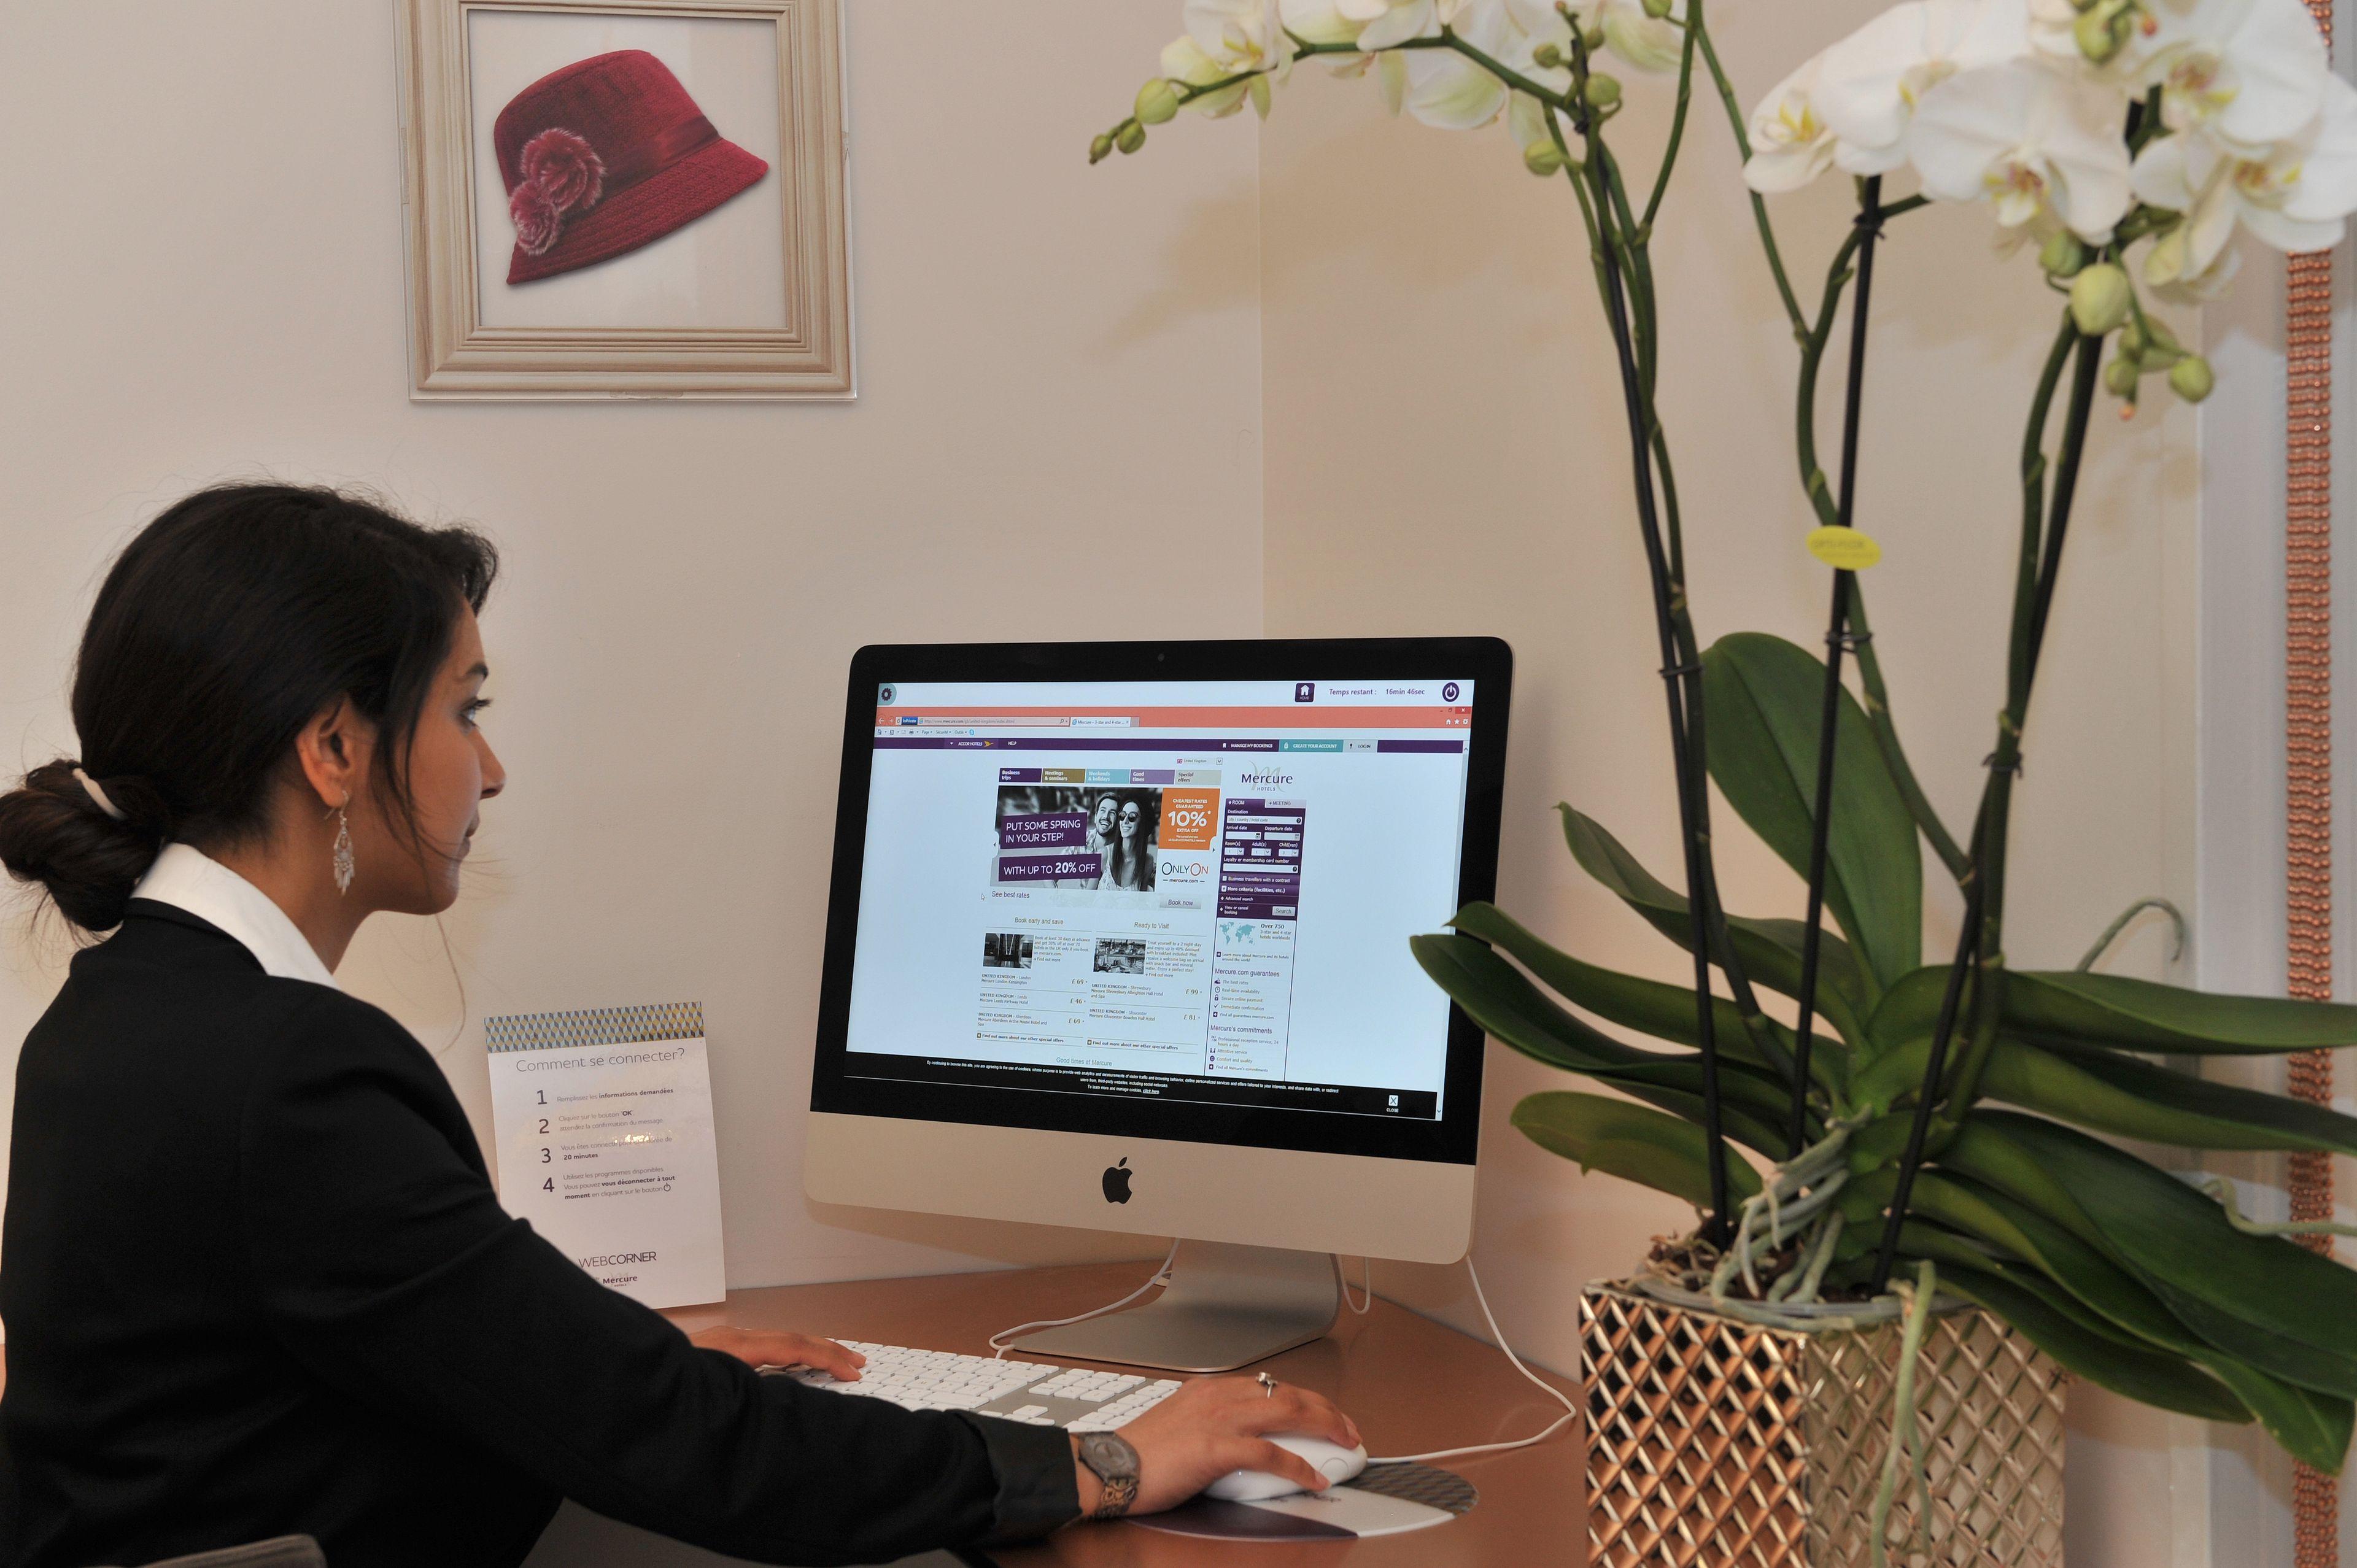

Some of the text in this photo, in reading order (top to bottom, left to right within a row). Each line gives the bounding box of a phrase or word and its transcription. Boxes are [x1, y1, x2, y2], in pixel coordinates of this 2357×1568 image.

[1241, 774, 1293, 784] Mercure
[1006, 819, 1081, 831] PUT SOME SPRING
[1005, 833, 1064, 843] IN YOUR STEP!
[1004, 862, 1096, 875] WITH UP TO 20% OFF
[516, 1047, 685, 1072] Comment se connecter?
[536, 1089, 548, 1105] 1
[557, 1094, 588, 1103] Remplissez
[598, 1091, 638, 1099] informations
[538, 1118, 550, 1134] 2
[592, 1121, 628, 1129] confirmation
[541, 1148, 551, 1164] 3
[543, 1177, 555, 1192] 4
[594, 1169, 632, 1179] programmes
[632, 1166, 664, 1175] disponibles
[617, 1176, 656, 1186] déconnecter
[578, 1251, 657, 1268] WEBCORNER
[603, 1275, 638, 1284] Mercure
